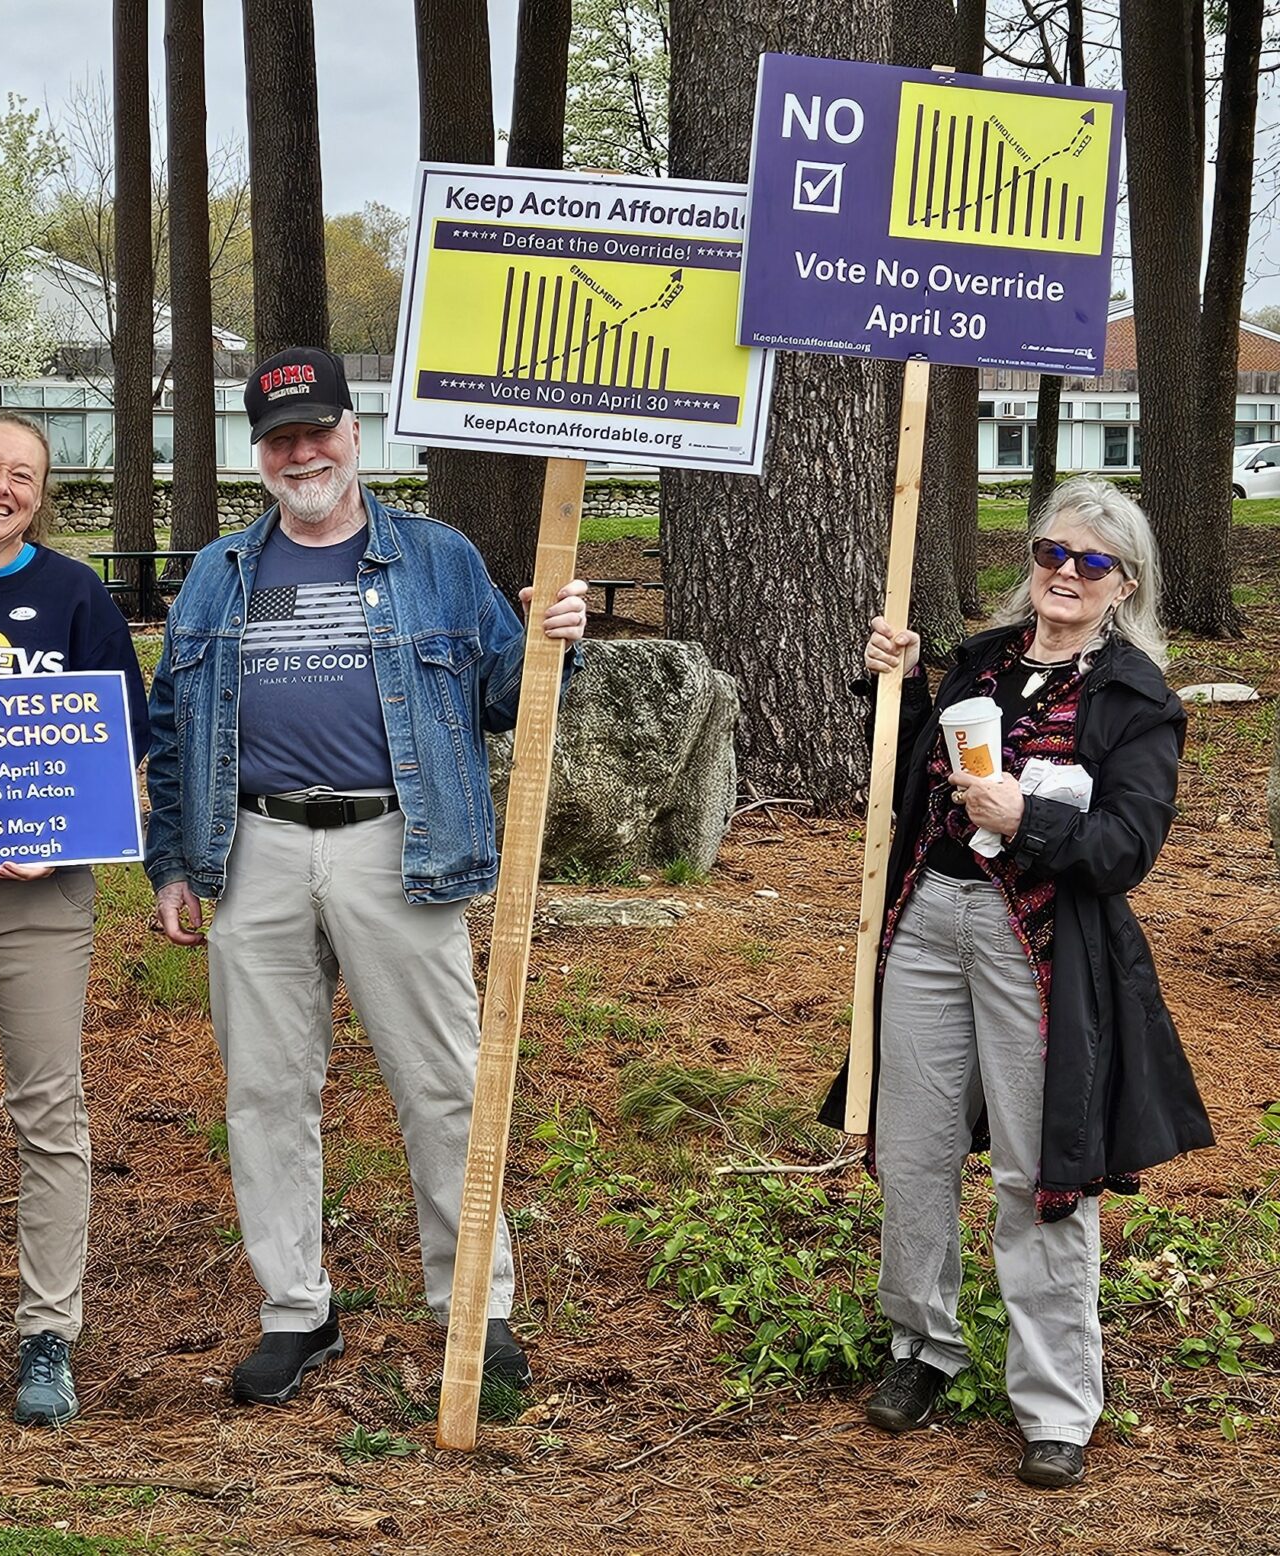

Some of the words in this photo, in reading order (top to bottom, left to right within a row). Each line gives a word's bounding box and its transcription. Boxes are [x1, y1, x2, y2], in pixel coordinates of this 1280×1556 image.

[781, 92, 864, 144] NO
[445, 186, 513, 217] Keep
[520, 191, 601, 220] Acton
[503, 232, 564, 252] Defeat
[569, 236, 598, 253] the
[605, 239, 691, 261] Override!
[570, 265, 623, 309] ENROLLMENT
[794, 251, 866, 284] Vote
[875, 260, 919, 289] No
[928, 265, 1064, 301] Override
[865, 305, 940, 339] April
[949, 312, 986, 341] 30
[491, 383, 531, 401] Vote
[537, 385, 565, 403] NO
[571, 392, 592, 405] on
[597, 390, 642, 411] April
[646, 396, 669, 411] 30
[464, 414, 682, 449] KeepActonAffordable.org
[284, 656, 301, 671] IS
[306, 654, 368, 670] GOOD
[51, 692, 100, 714] FOR
[44, 761, 66, 775] 30
[7, 785, 22, 799] in
[27, 785, 74, 799] Acton
[8, 817, 44, 836] May
[48, 817, 66, 832] 13
